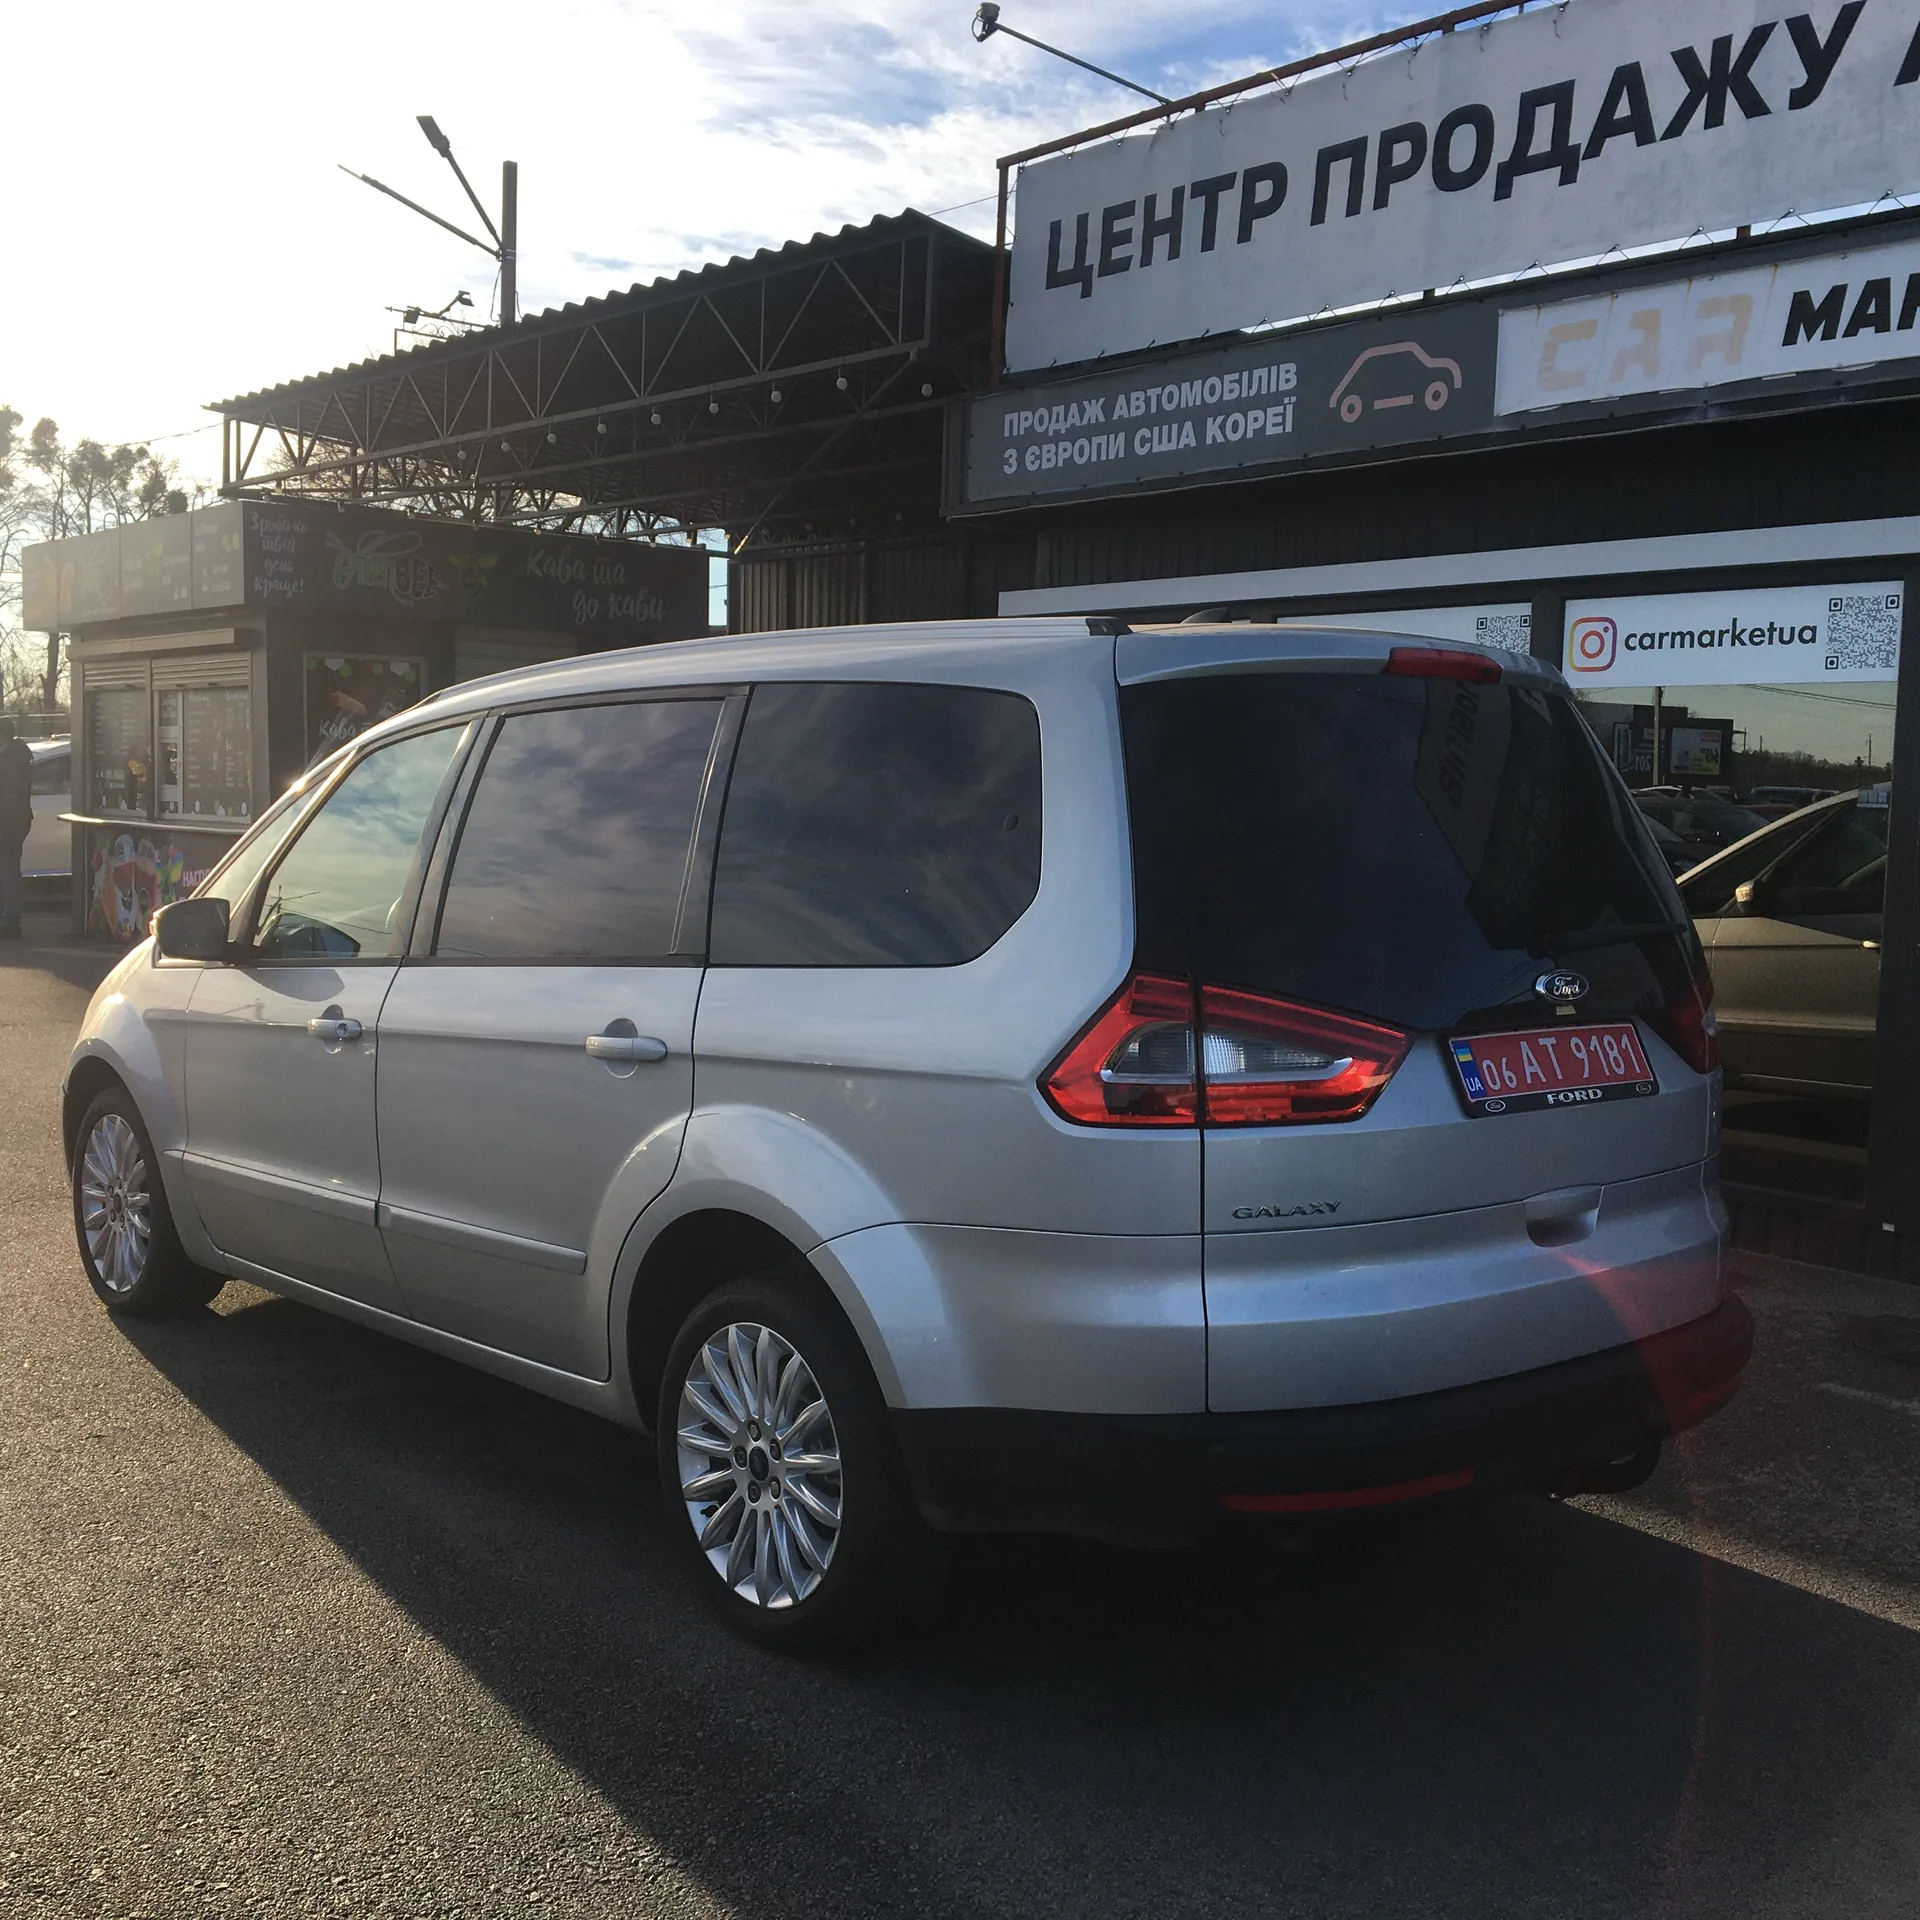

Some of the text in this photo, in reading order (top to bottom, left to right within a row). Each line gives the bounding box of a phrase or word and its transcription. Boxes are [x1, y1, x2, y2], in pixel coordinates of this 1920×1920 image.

[1046, 0, 1868, 298] ЦЕНТР ПРОДАЖУ
[1004, 362, 1298, 437] ПРОДАЖ АВТОМОБІЛІВ
[1003, 396, 1297, 474] З ЄВРОПИ США КОРЕЇ
[527, 546, 587, 584] Кава
[572, 585, 663, 625] до кави
[1624, 618, 1818, 651] carmarketua
[1553, 976, 1580, 996] Ford
[1482, 1034, 1641, 1091] 06 AT 9181
[1466, 1077, 1484, 1093] UA
[1547, 1088, 1603, 1104] FORD
[1232, 1200, 1340, 1219] GALAXY
